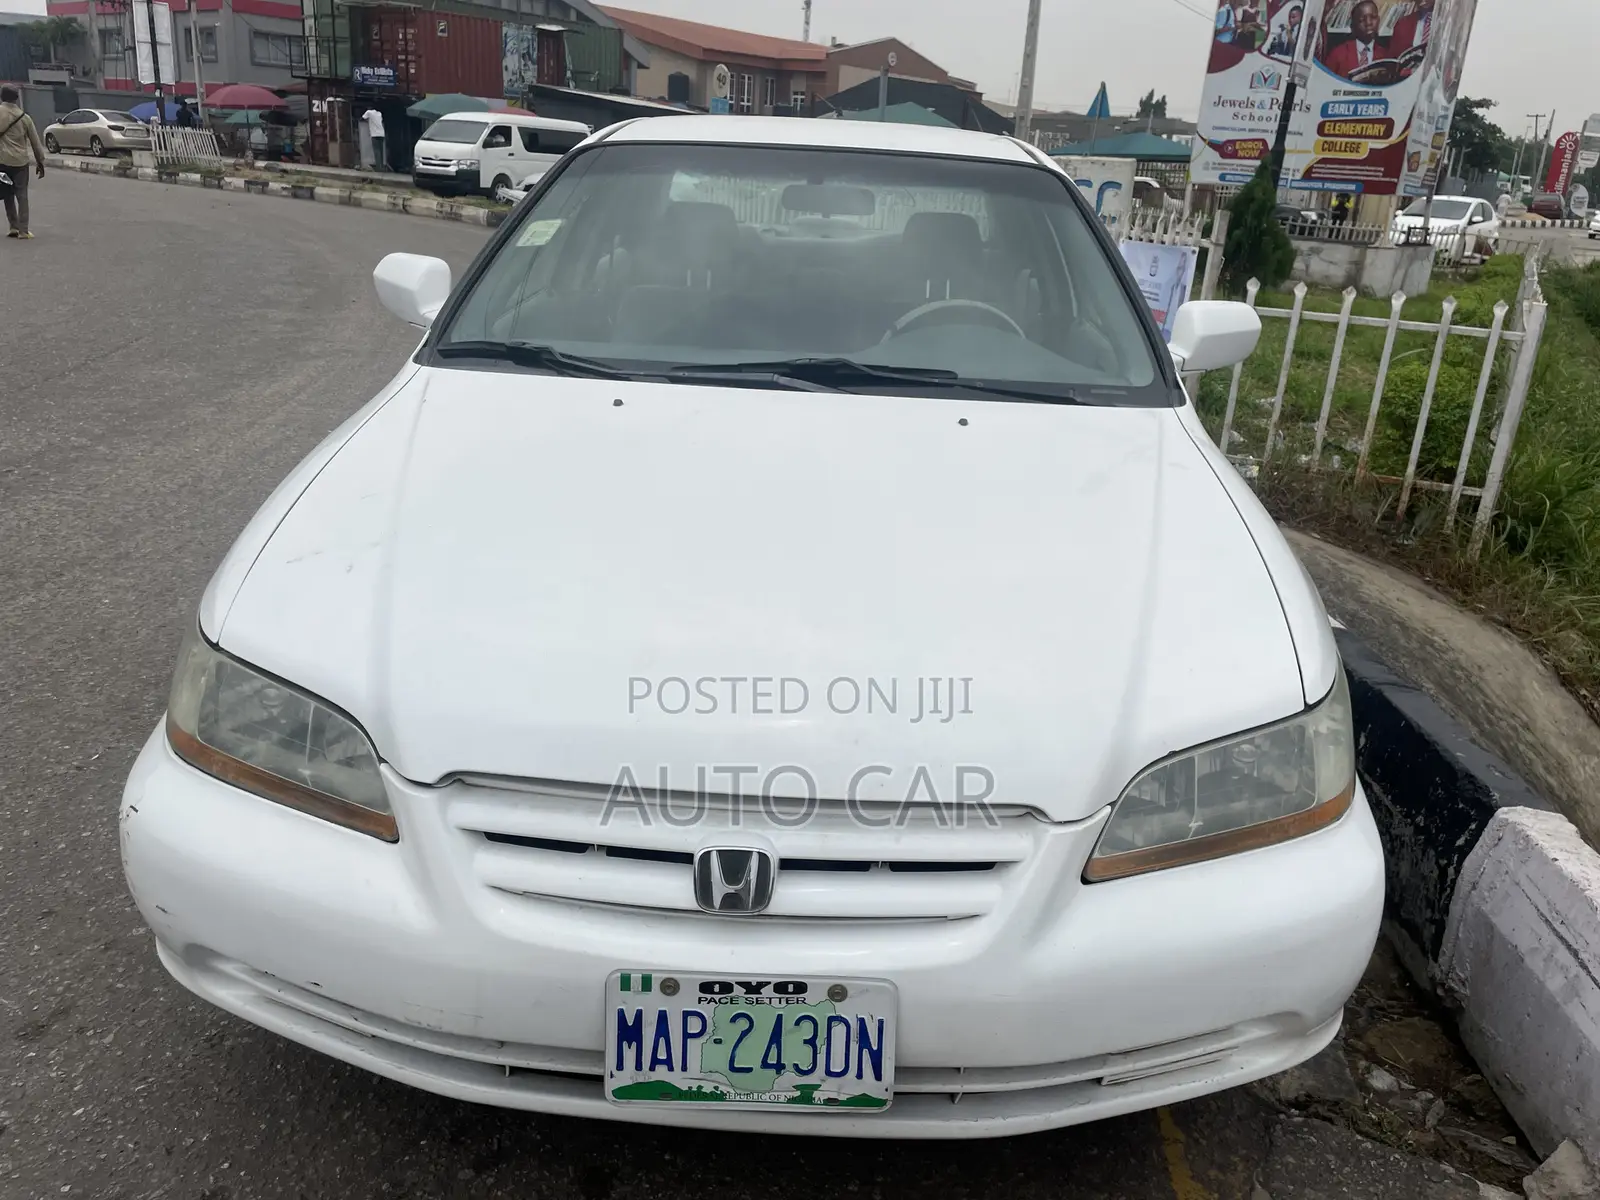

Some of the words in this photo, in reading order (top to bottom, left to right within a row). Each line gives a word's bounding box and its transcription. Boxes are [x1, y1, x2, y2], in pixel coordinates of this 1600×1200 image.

[716, 72, 727, 86] 40
[1213, 95, 1256, 110] Jewels
[1256, 99, 1266, 110] &
[1268, 97, 1312, 114] Perls
[1327, 103, 1355, 115] EARLY
[1357, 104, 1386, 116] YEARS
[1324, 121, 1387, 136] ELEMENTARY
[1235, 140, 1264, 149] ENROL
[1321, 141, 1362, 154] COLLEGE
[1237, 149, 1261, 157] NOW
[698, 980, 808, 996] OYO
[697, 996, 740, 1006] PACE
[744, 996, 807, 1006] SETTER
[616, 1007, 885, 1082] MAP-243DN
[723, 1091, 768, 1102] REPUBLIC
[768, 1093, 782, 1102] OF
